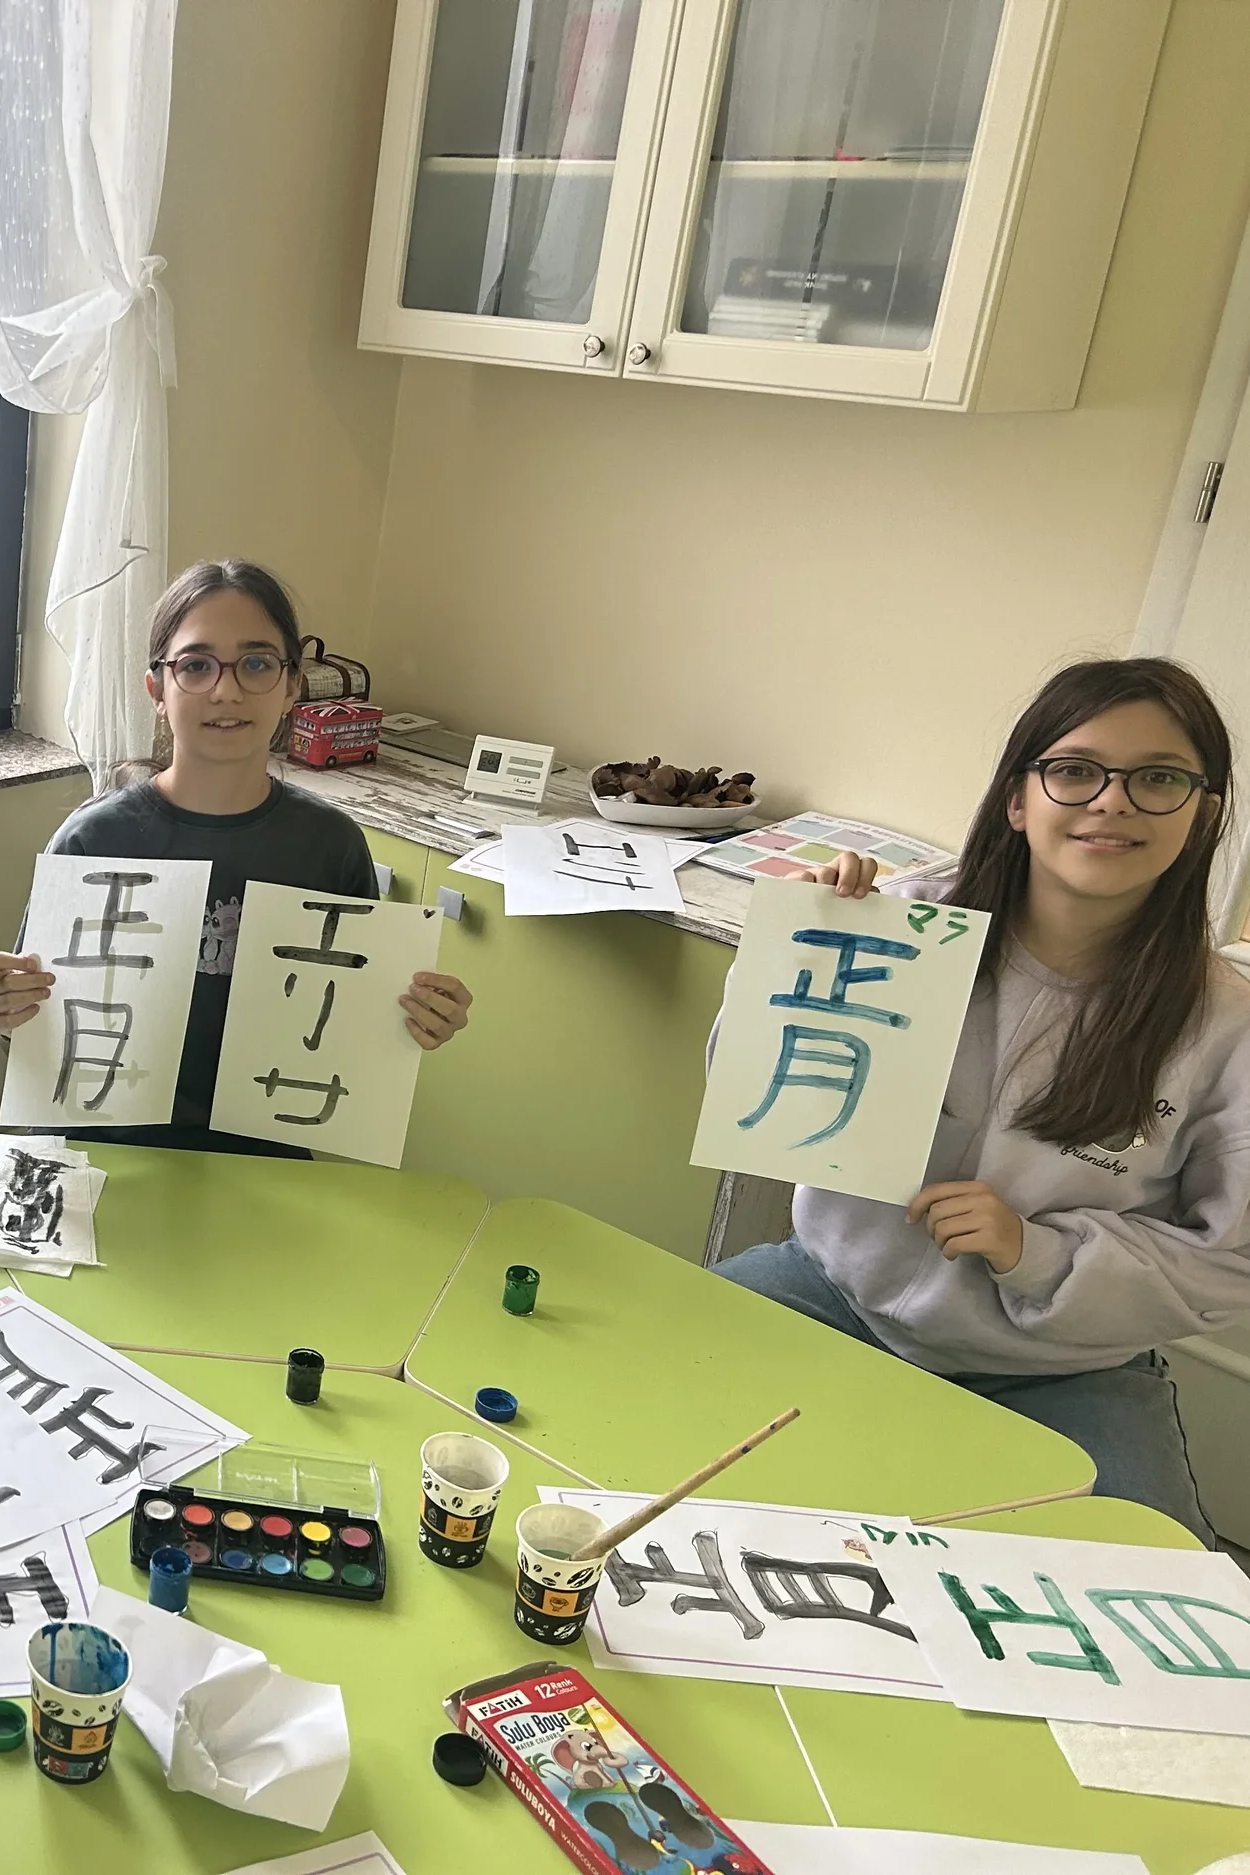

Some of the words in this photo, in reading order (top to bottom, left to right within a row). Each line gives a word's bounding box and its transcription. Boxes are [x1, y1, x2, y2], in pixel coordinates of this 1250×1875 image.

[736, 928, 922, 1150] 正月
[1154, 1099, 1177, 1119] OF
[533, 1682, 556, 1700] 12
[550, 1678, 573, 1690] Renk
[555, 1684, 578, 1696] Colours
[499, 1720, 536, 1745] Sulu
[530, 1712, 571, 1735] Boya
[514, 1740, 537, 1752] WATER
[535, 1731, 562, 1745] COLOURS
[509, 1770, 557, 1832] SULUBOYA
